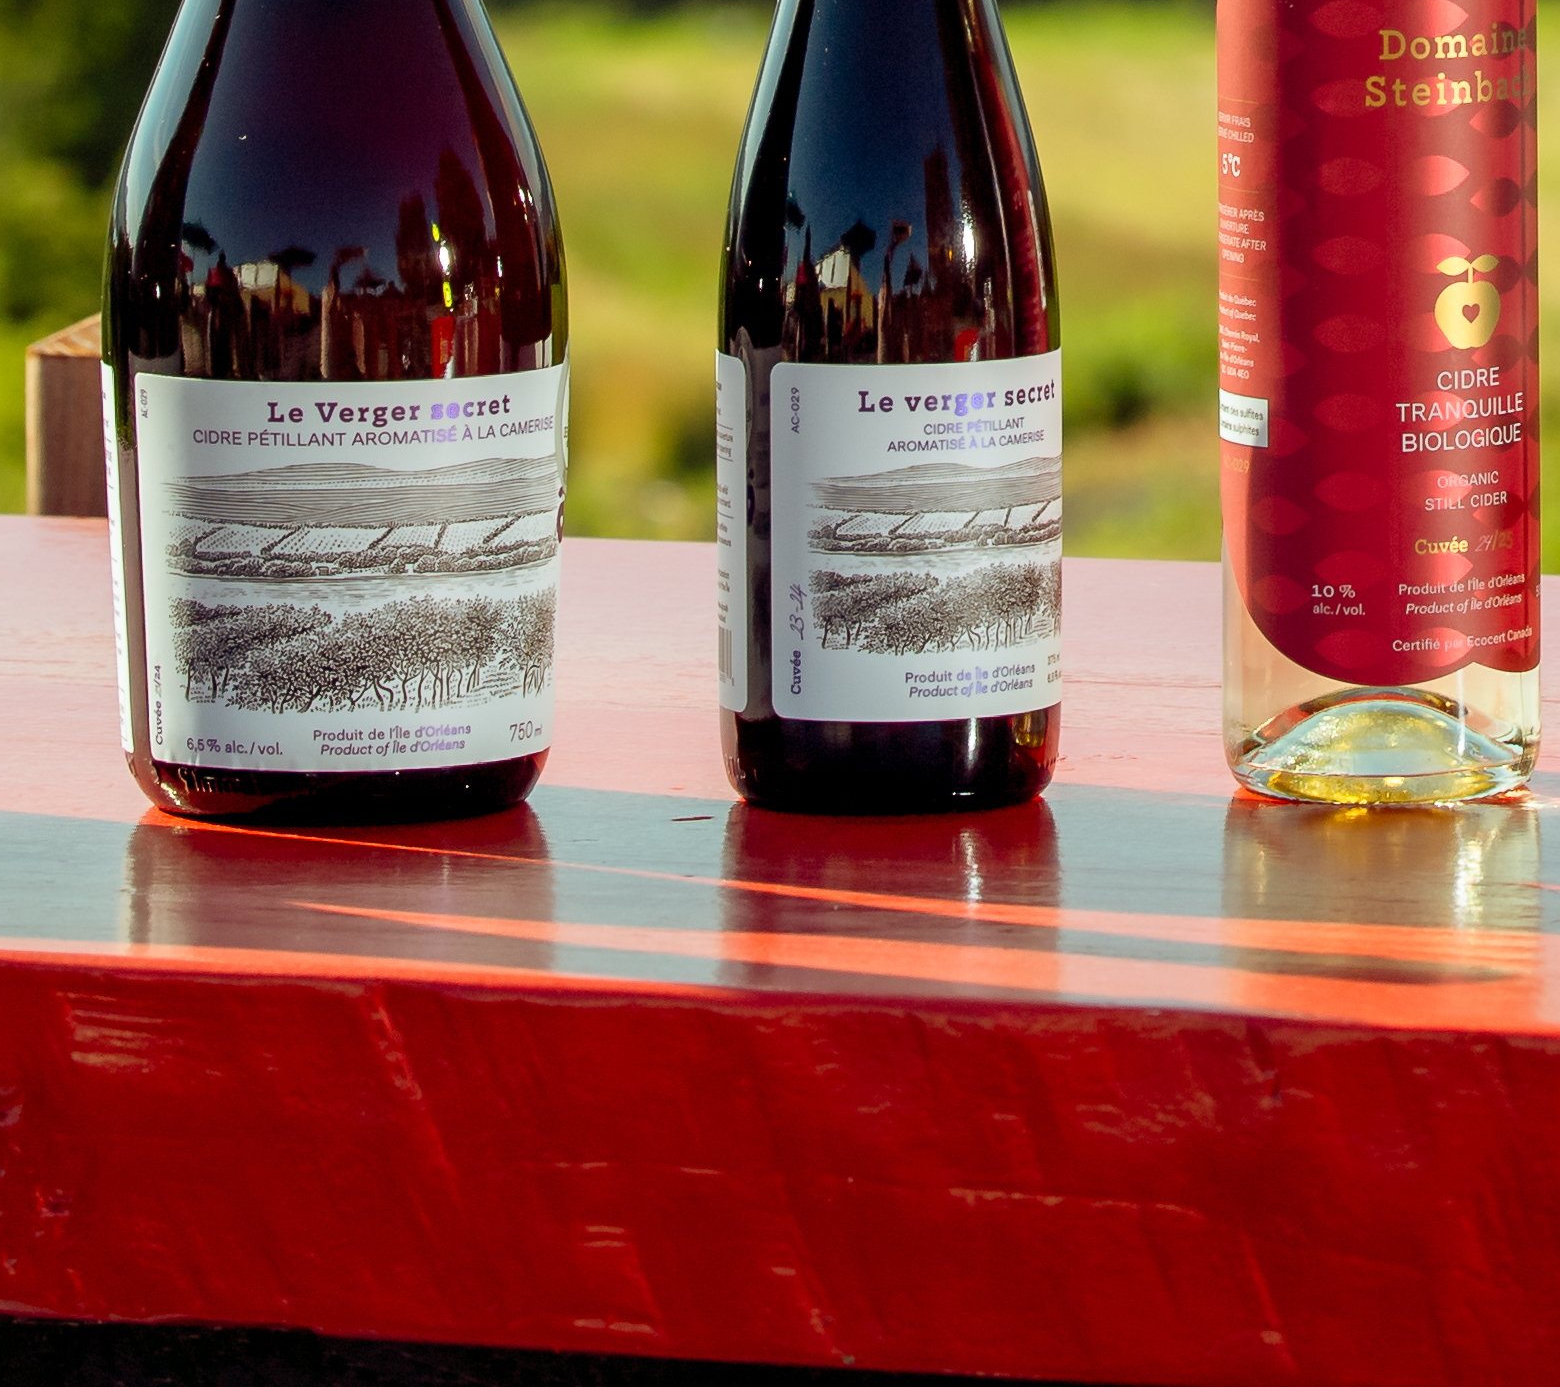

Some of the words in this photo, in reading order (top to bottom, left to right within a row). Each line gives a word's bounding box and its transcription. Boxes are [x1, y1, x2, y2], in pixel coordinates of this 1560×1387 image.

[1379, 23, 1527, 60] Domaine
[1365, 65, 1531, 107] Steinbach
[1438, 367, 1499, 390] CIDRE
[858, 390, 893, 413] Le
[905, 393, 996, 416] verger
[1004, 380, 1055, 406] secret
[1396, 393, 1523, 422] TRANQUILLE
[267, 402, 303, 423] Le
[315, 402, 420, 427] Verger
[431, 395, 510, 419] secret
[193, 430, 242, 446] CIDRE
[248, 428, 346, 447] PÉTILLANT
[352, 425, 456, 446] AROMATISÉ
[462, 423, 473, 440] À
[478, 424, 495, 439] LA
[500, 415, 553, 437] CAMERISE
[924, 422, 963, 435] CIDRE
[968, 417, 1024, 434] PÉTILLANT
[887, 438, 965, 452] AROMATISÉ
[969, 434, 978, 449] À
[982, 436, 996, 448] LA
[999, 429, 1044, 446] CAMERISE
[1402, 424, 1522, 452] BIOLOGIQUE
[1437, 471, 1499, 488] ORGANIC
[1425, 497, 1465, 510] STILL
[1471, 492, 1508, 508] CIDER
[1415, 536, 1468, 555] Cuvée
[790, 650, 802, 695] Cuvée
[905, 671, 952, 683] Produit
[910, 685, 958, 698] Product
[155, 702, 163, 745] Cuvée
[313, 729, 362, 741] Produit
[368, 728, 386, 740] de
[320, 742, 374, 756] Product
[377, 741, 391, 756] of
